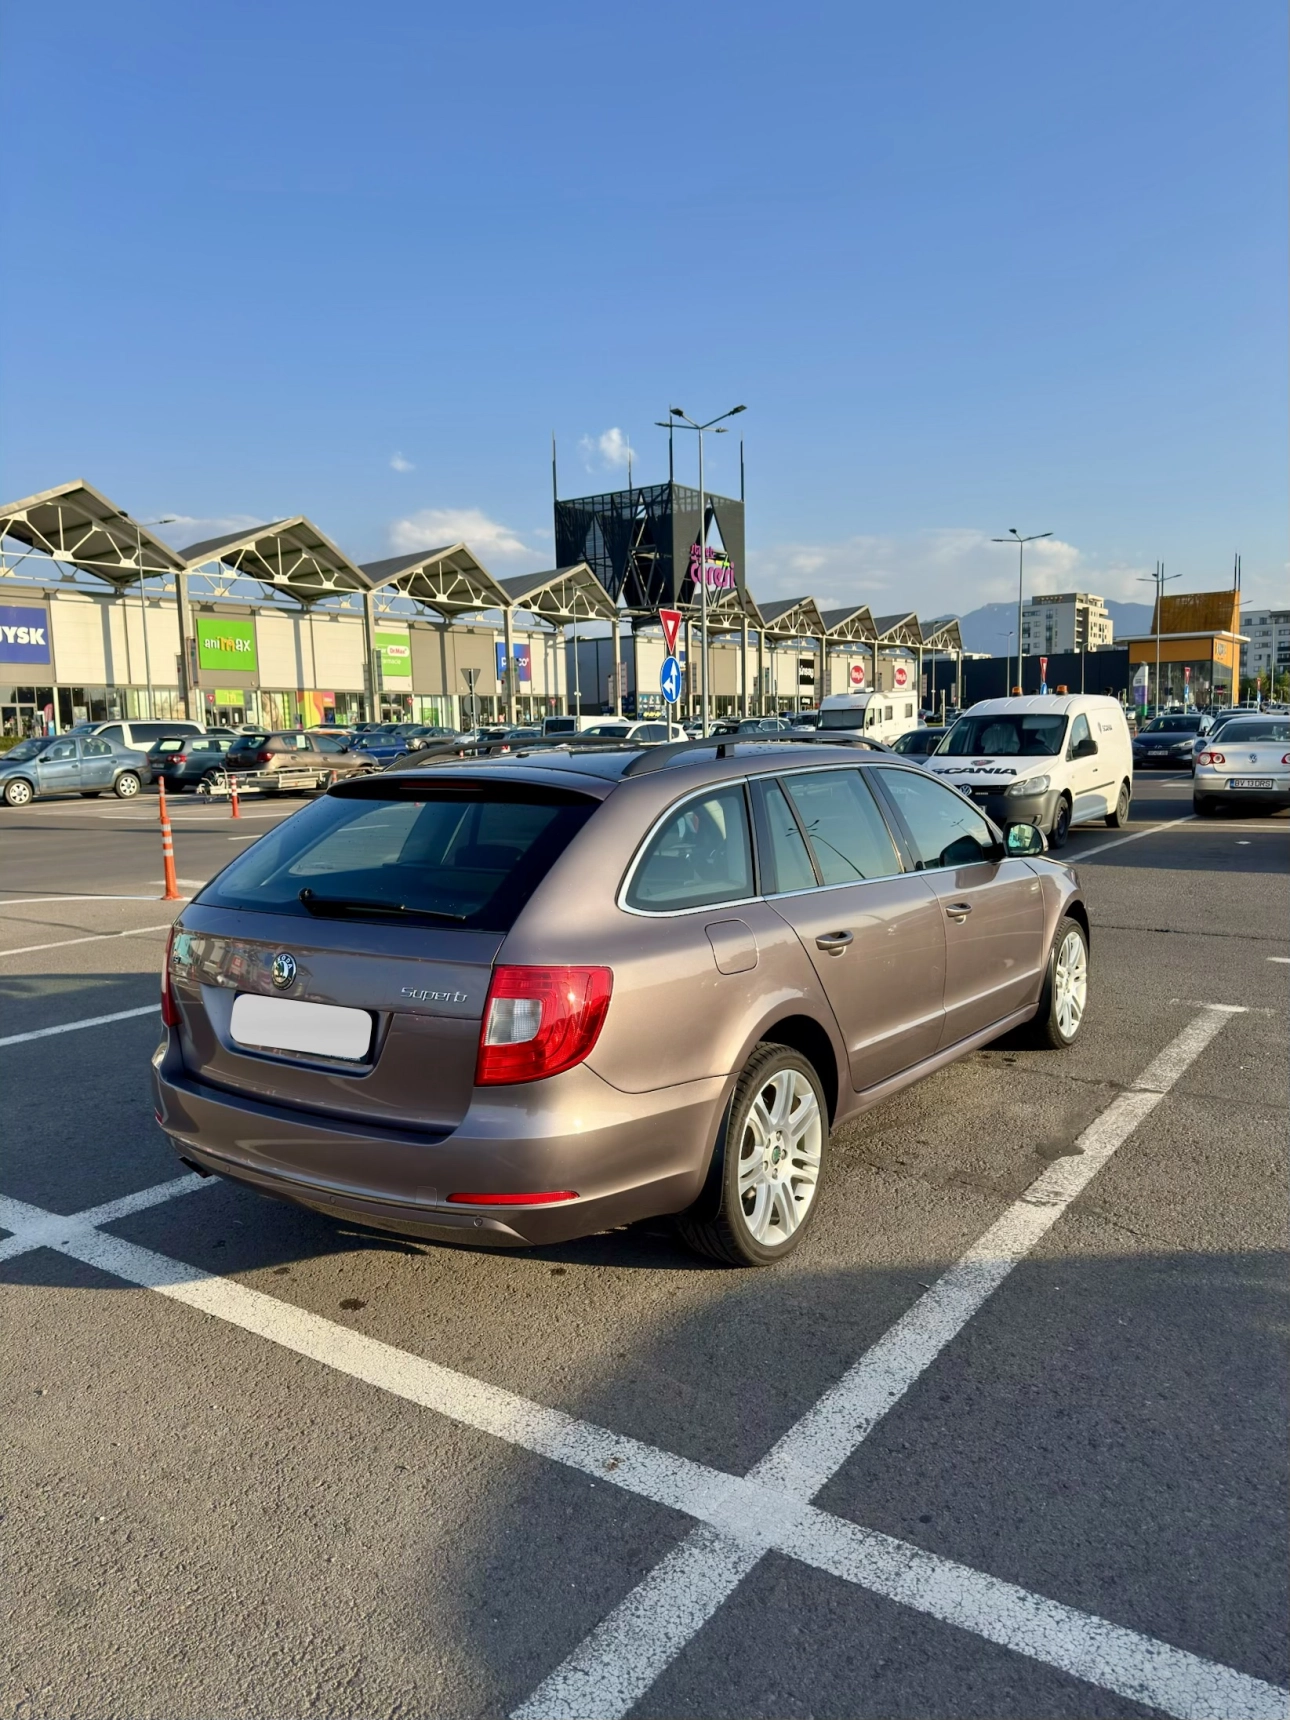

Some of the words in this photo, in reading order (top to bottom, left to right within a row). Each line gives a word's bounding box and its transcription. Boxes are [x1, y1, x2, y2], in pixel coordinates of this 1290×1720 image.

[0, 626, 46, 645] YSK
[501, 657, 529, 667] pco
[932, 767, 1017, 776] SCANIA
[400, 987, 468, 1003] Superb
